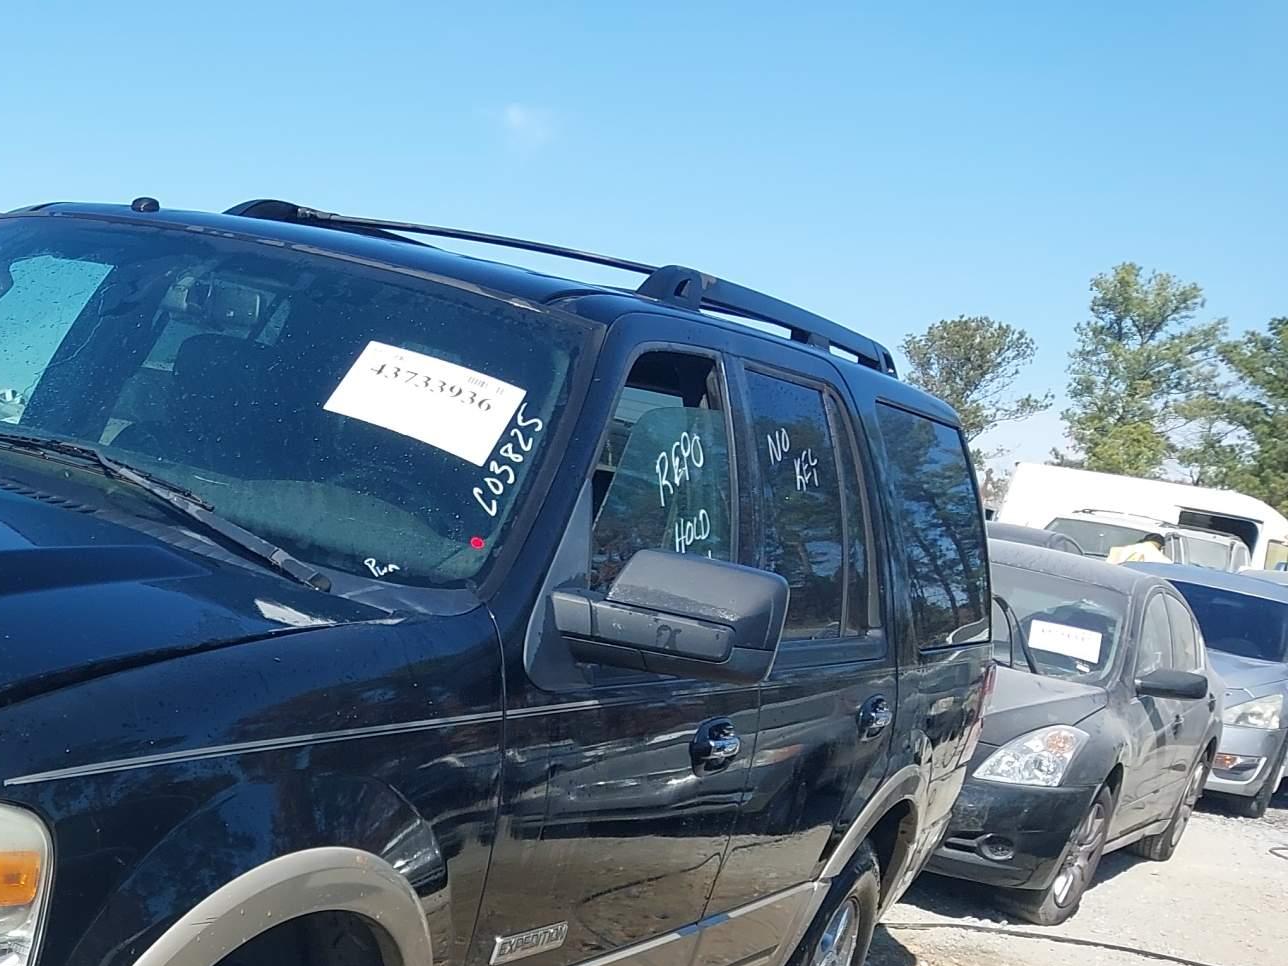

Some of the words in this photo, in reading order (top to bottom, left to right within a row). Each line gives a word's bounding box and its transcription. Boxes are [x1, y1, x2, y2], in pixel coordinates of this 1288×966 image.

[370, 363, 492, 412] 43733936
[655, 431, 705, 507] REPO
[767, 427, 791, 465] NO
[674, 509, 711, 553] HOLD
